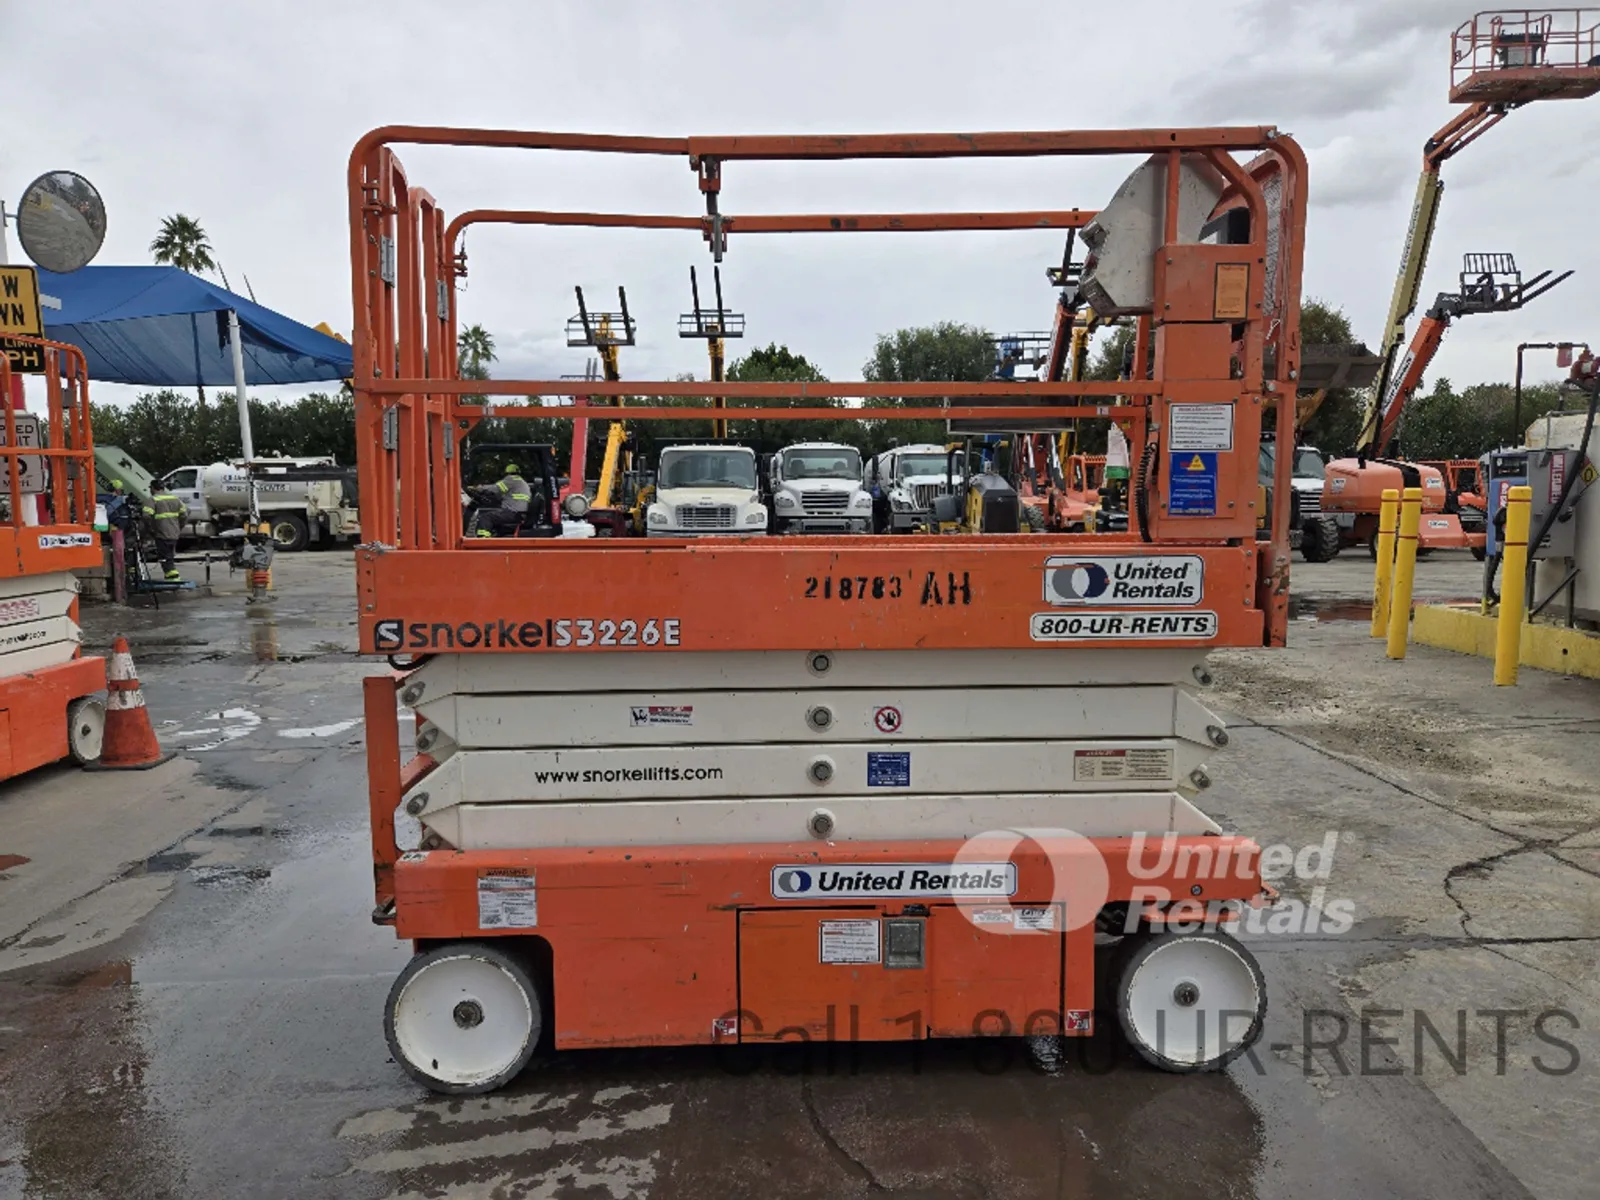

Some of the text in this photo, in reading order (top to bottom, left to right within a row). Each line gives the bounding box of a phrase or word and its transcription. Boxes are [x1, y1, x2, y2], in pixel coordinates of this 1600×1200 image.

[1114, 562, 1189, 581] United
[920, 571, 972, 605] AH
[1112, 581, 1194, 599] Rentals
[409, 619, 552, 648] snorkel
[554, 619, 681, 647] S3226E
[1040, 616, 1209, 634] 800-UR-RENTS
[818, 869, 1004, 892] United Rentals
